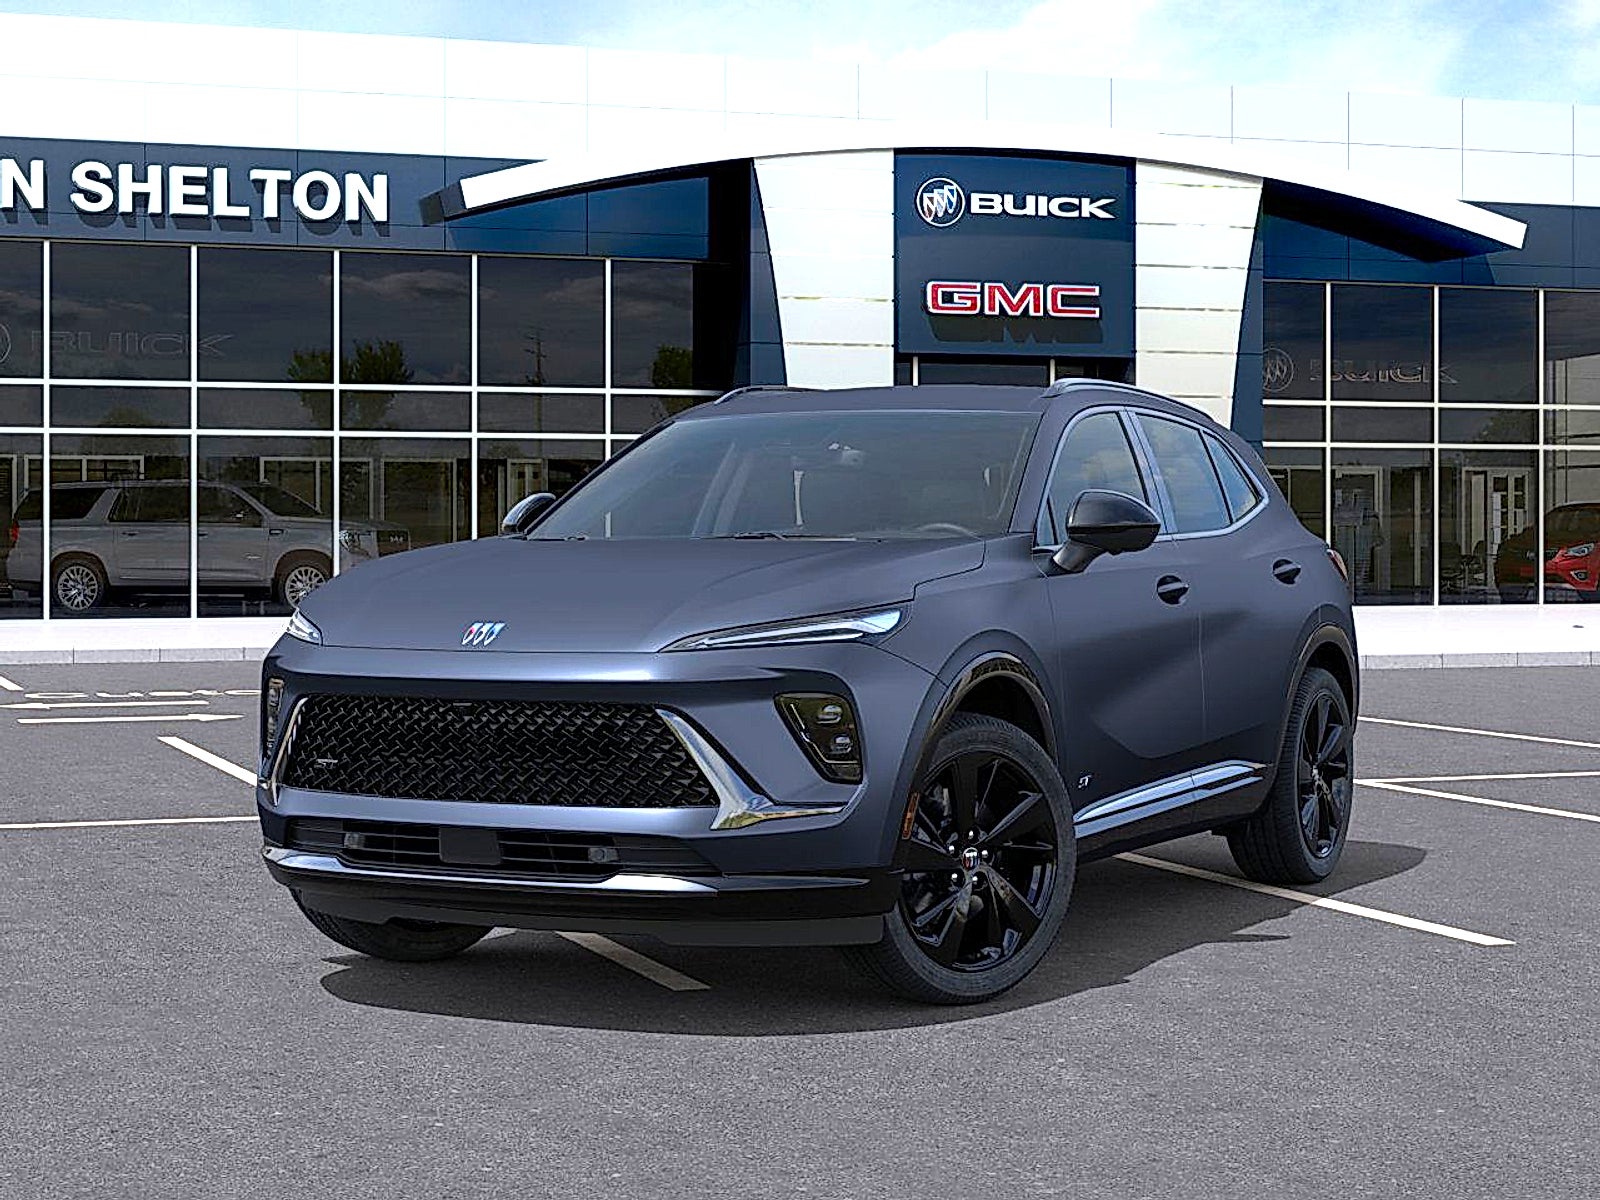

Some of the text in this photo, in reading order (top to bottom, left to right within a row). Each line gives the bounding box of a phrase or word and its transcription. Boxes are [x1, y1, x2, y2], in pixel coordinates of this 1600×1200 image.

[70, 160, 388, 222] SHELTON
[970, 192, 1117, 219] BUICK
[926, 281, 1100, 318] GMC
